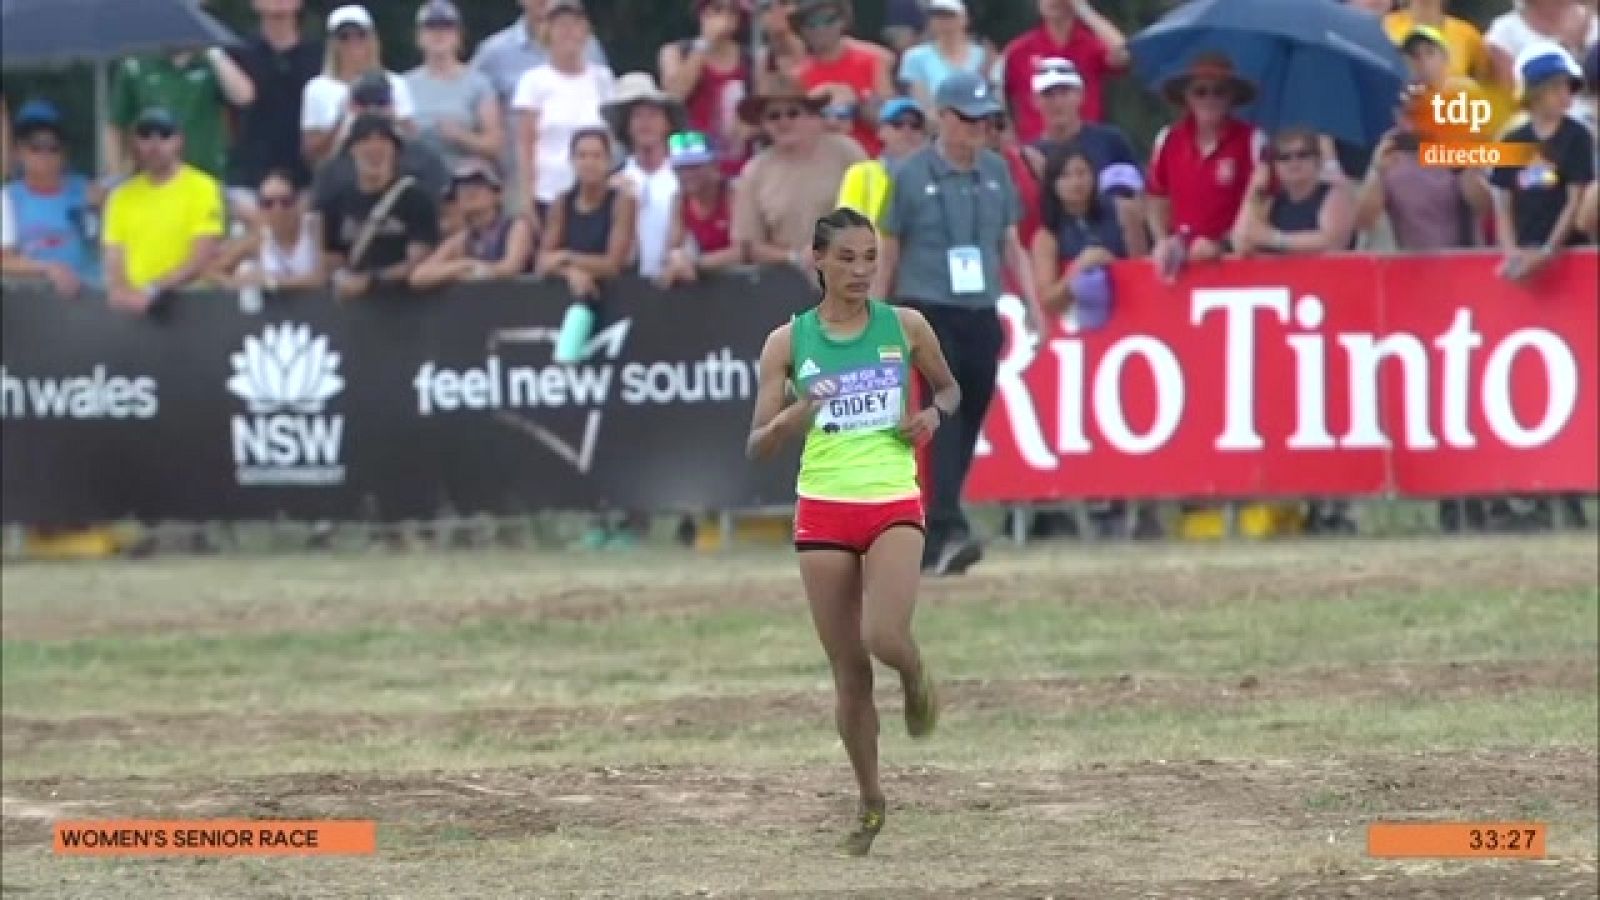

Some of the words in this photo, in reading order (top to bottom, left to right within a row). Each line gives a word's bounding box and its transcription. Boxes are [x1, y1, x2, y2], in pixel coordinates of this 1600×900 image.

[28, 364, 158, 418] wales
[413, 355, 500, 415] feel
[508, 364, 613, 407] new
[621, 348, 748, 404] south
[1190, 287, 1578, 452] Tinto
[829, 391, 889, 418] GIDEY
[231, 414, 345, 464] NSW
